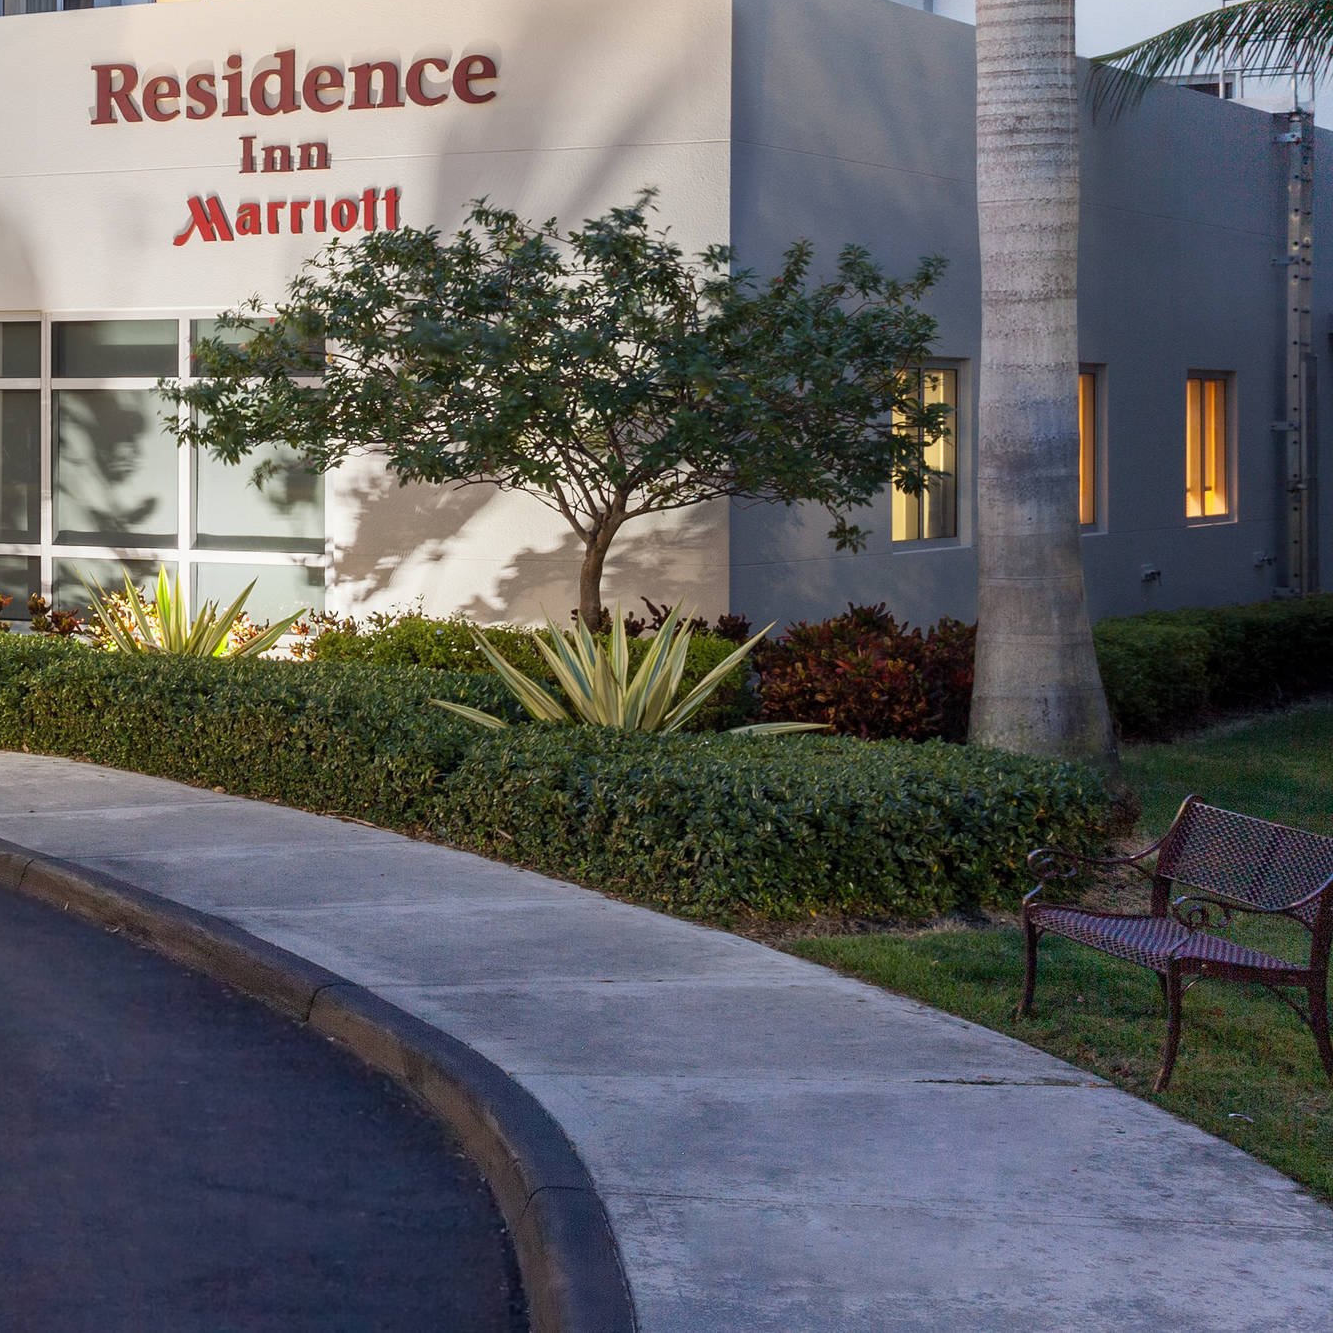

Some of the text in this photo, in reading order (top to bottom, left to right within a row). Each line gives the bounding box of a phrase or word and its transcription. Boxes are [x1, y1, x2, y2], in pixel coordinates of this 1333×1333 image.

[90, 48, 498, 125] Residence
[239, 134, 331, 174] Inn
[173, 186, 401, 246] Marriott
